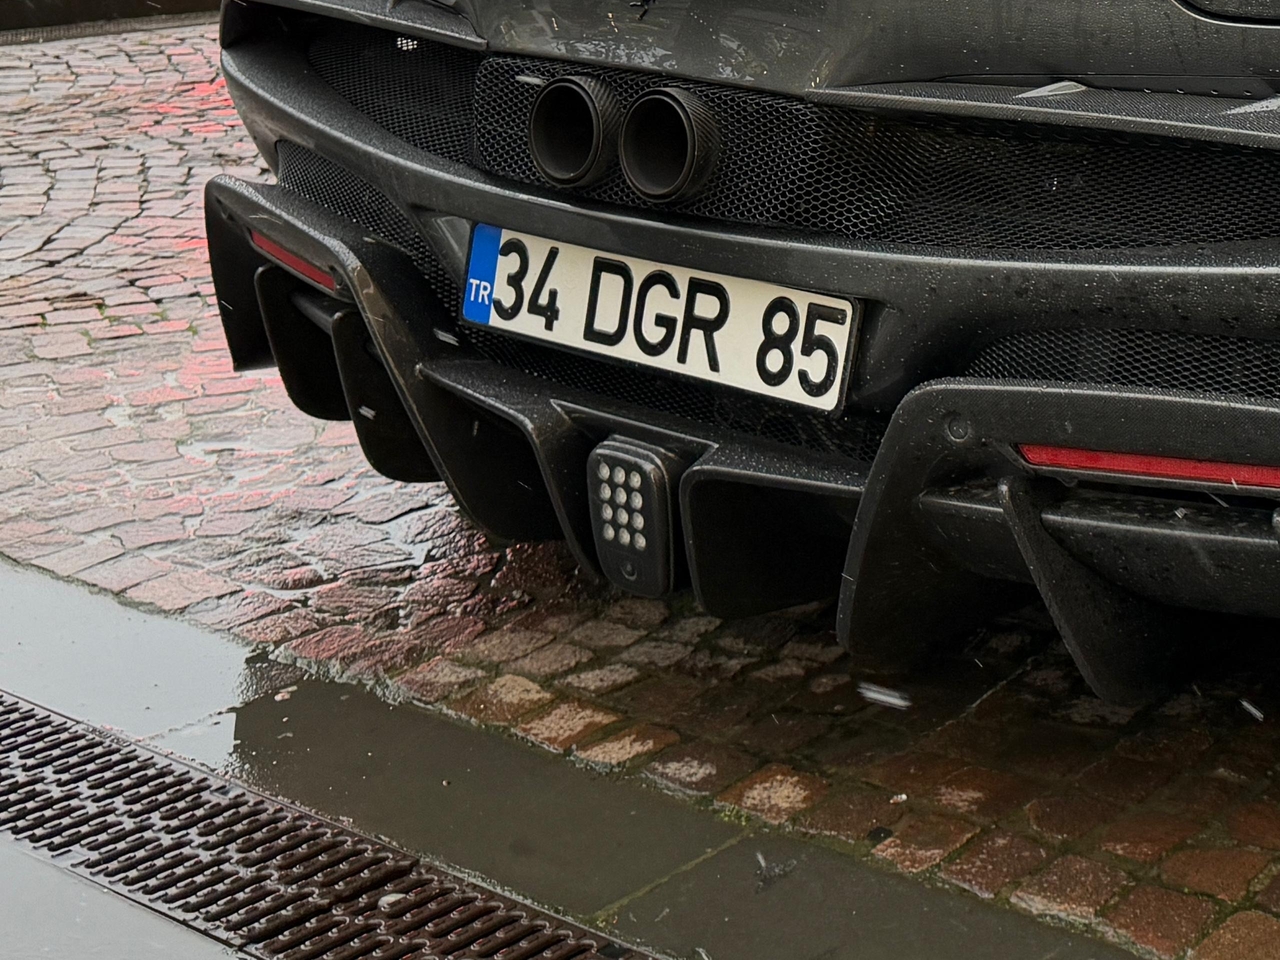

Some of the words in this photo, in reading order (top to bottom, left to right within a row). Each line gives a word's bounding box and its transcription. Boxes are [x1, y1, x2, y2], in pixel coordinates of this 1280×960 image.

[469, 278, 492, 305] TR
[492, 237, 560, 332] 34
[582, 255, 731, 373] DGR
[755, 296, 848, 398] 85
